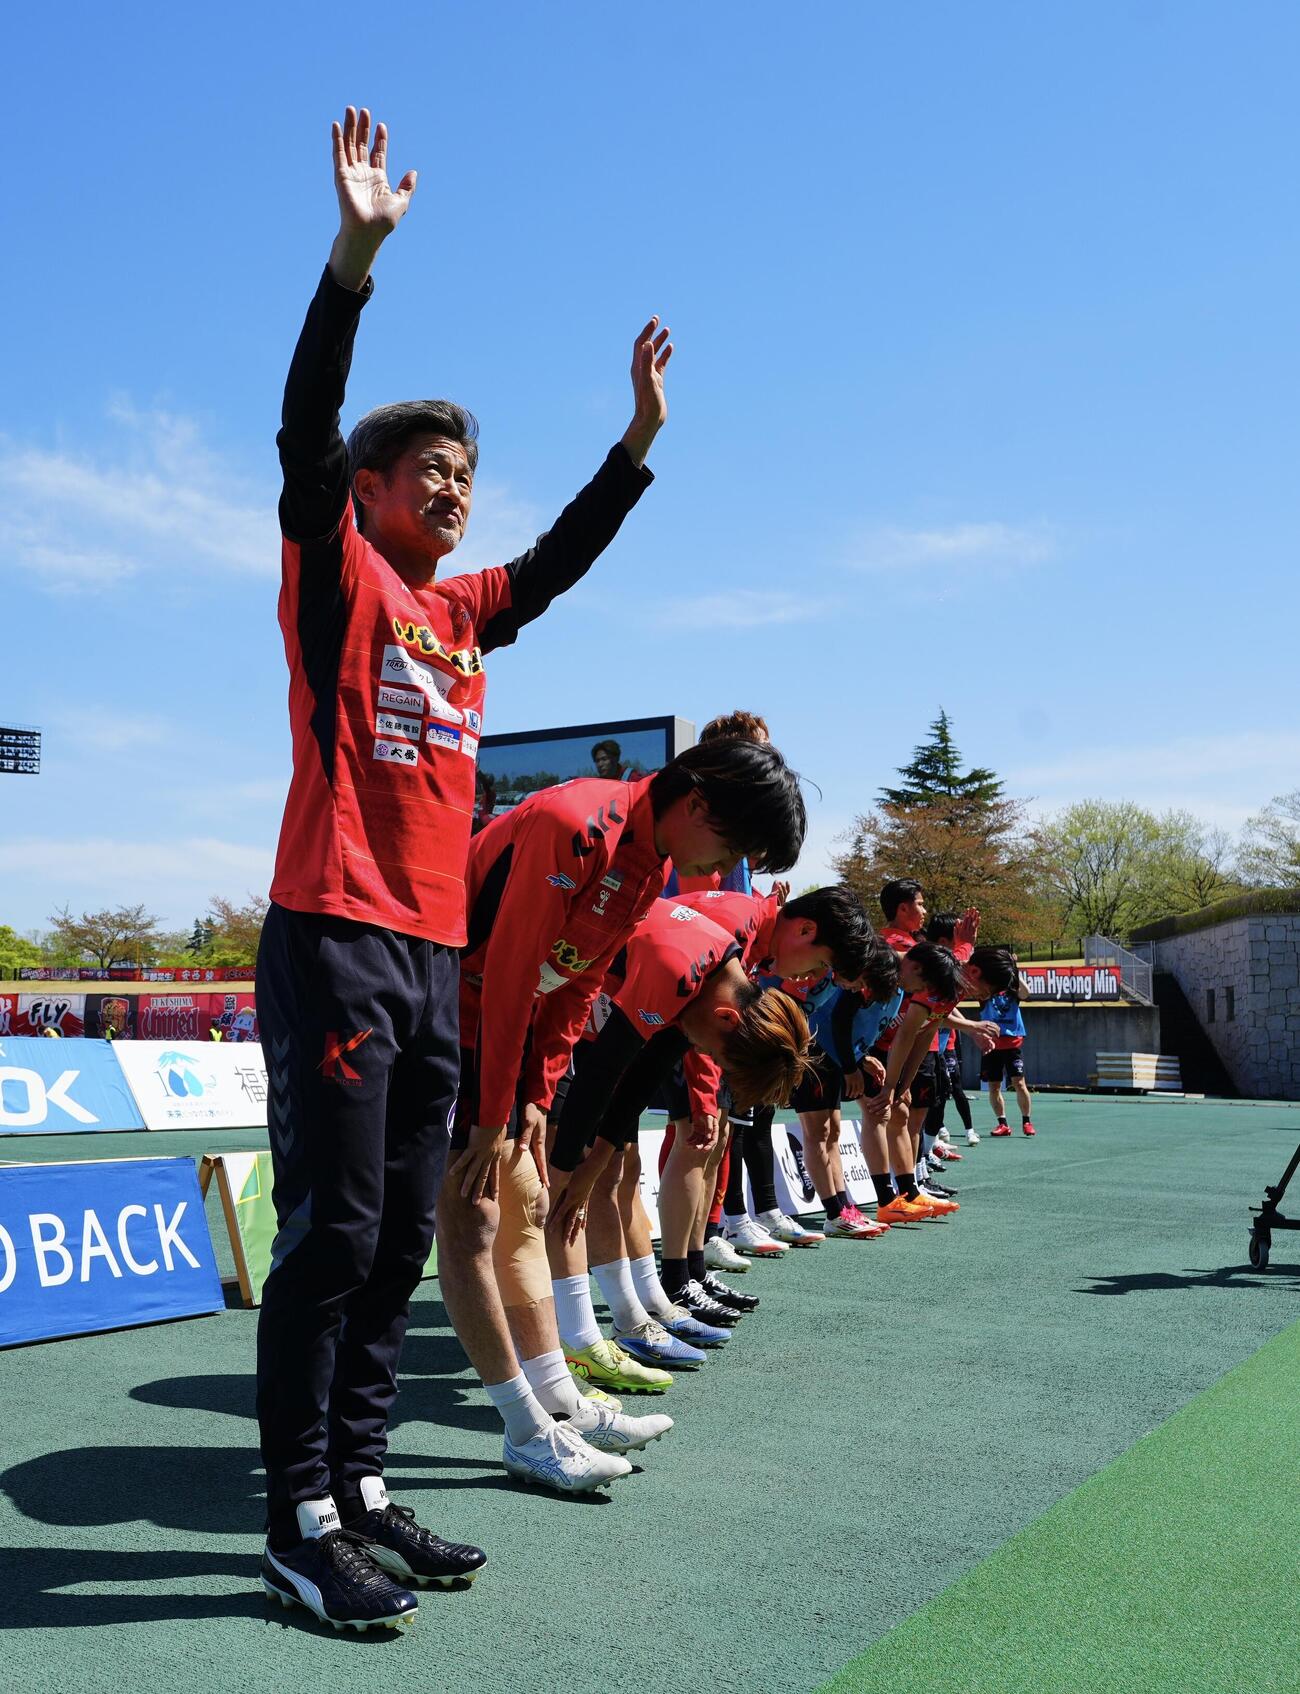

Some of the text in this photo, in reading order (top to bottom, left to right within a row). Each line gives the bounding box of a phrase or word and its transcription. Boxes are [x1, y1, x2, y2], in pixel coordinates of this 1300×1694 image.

[381, 692, 421, 708] REGAIN
[1047, 970, 1092, 999] Hyeong
[1095, 969, 1117, 994] Min
[151, 996, 193, 1008] FUKUSHIMA
[30, 1000, 69, 1025] FLY
[839, 1142, 858, 1157] urry
[850, 1164, 870, 1181] dish
[28, 1202, 201, 1288] BACK
